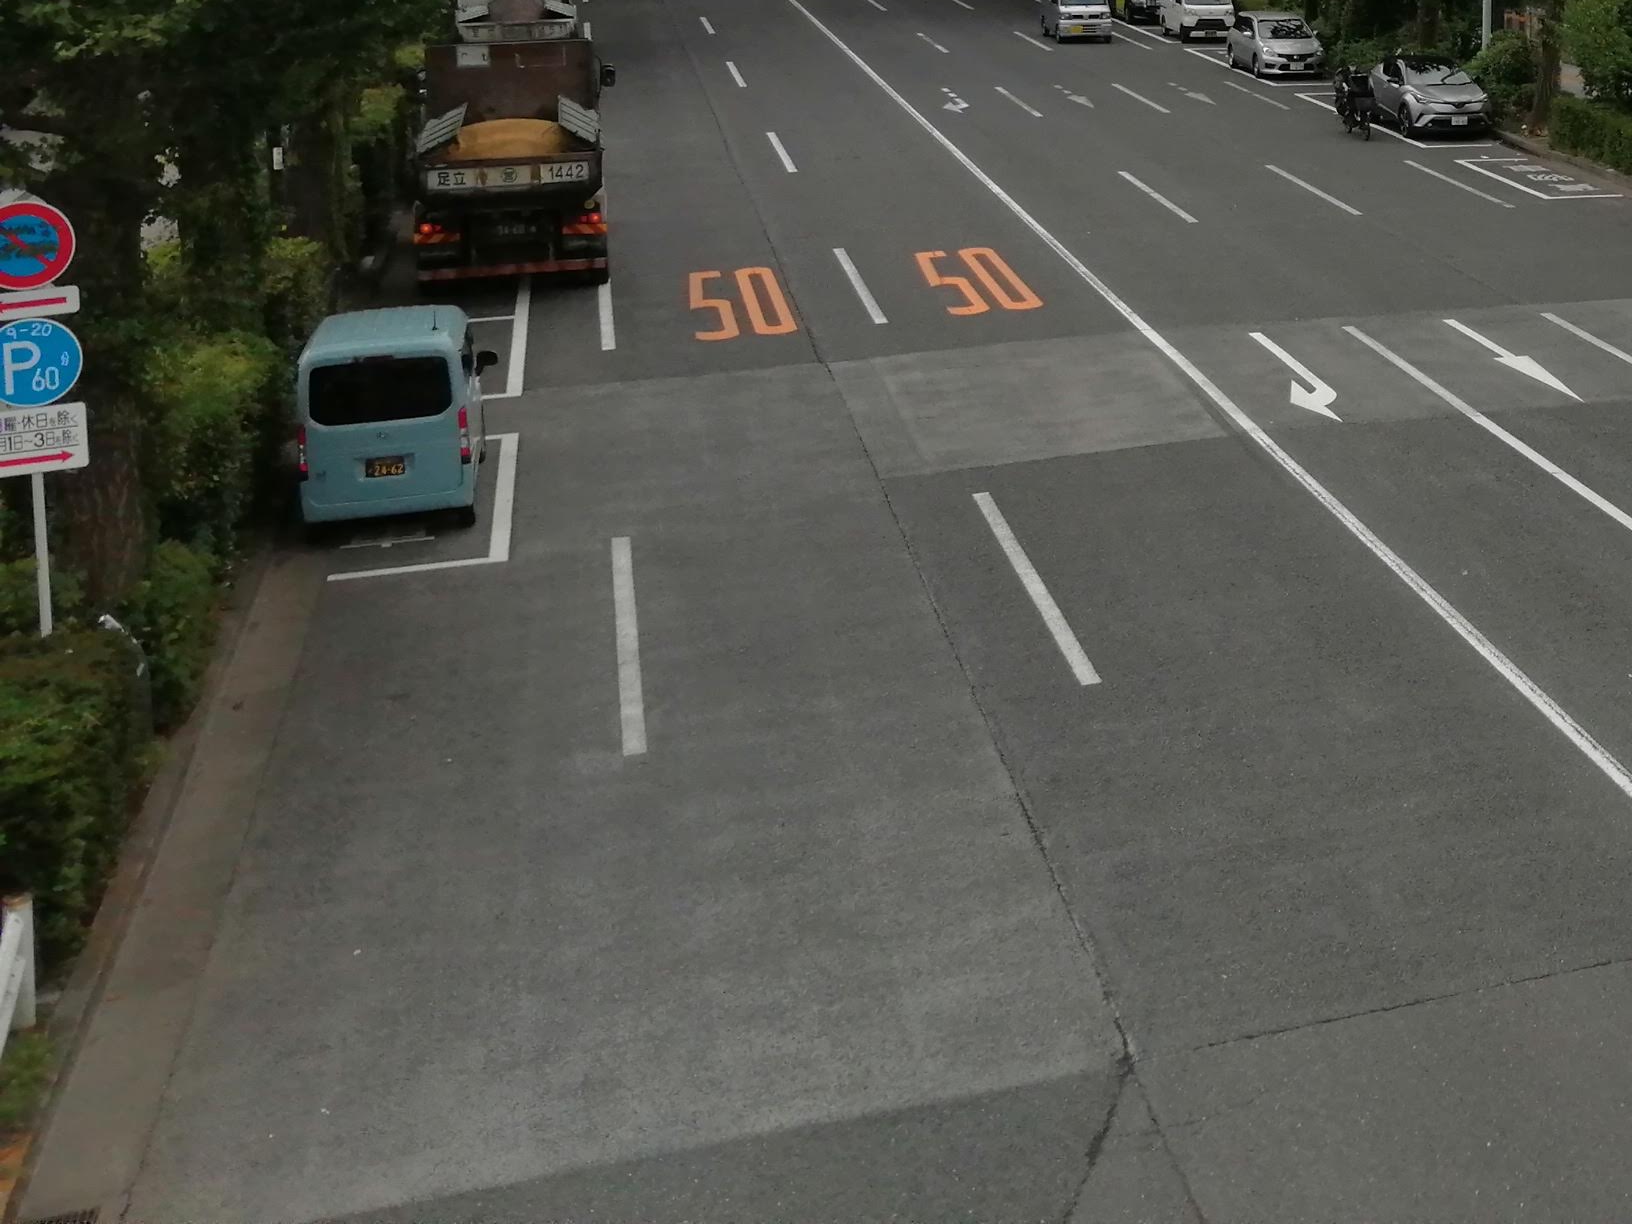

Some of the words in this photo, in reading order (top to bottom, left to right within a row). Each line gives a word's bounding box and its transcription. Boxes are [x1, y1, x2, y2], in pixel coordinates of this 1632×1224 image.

[437, 171, 466, 187] 足立
[549, 164, 584, 180] 1442
[914, 247, 1044, 316] 50
[689, 266, 798, 341] 50
[6, 323, 52, 339] 9-20
[3, 340, 42, 396] P
[31, 366, 60, 392] 60
